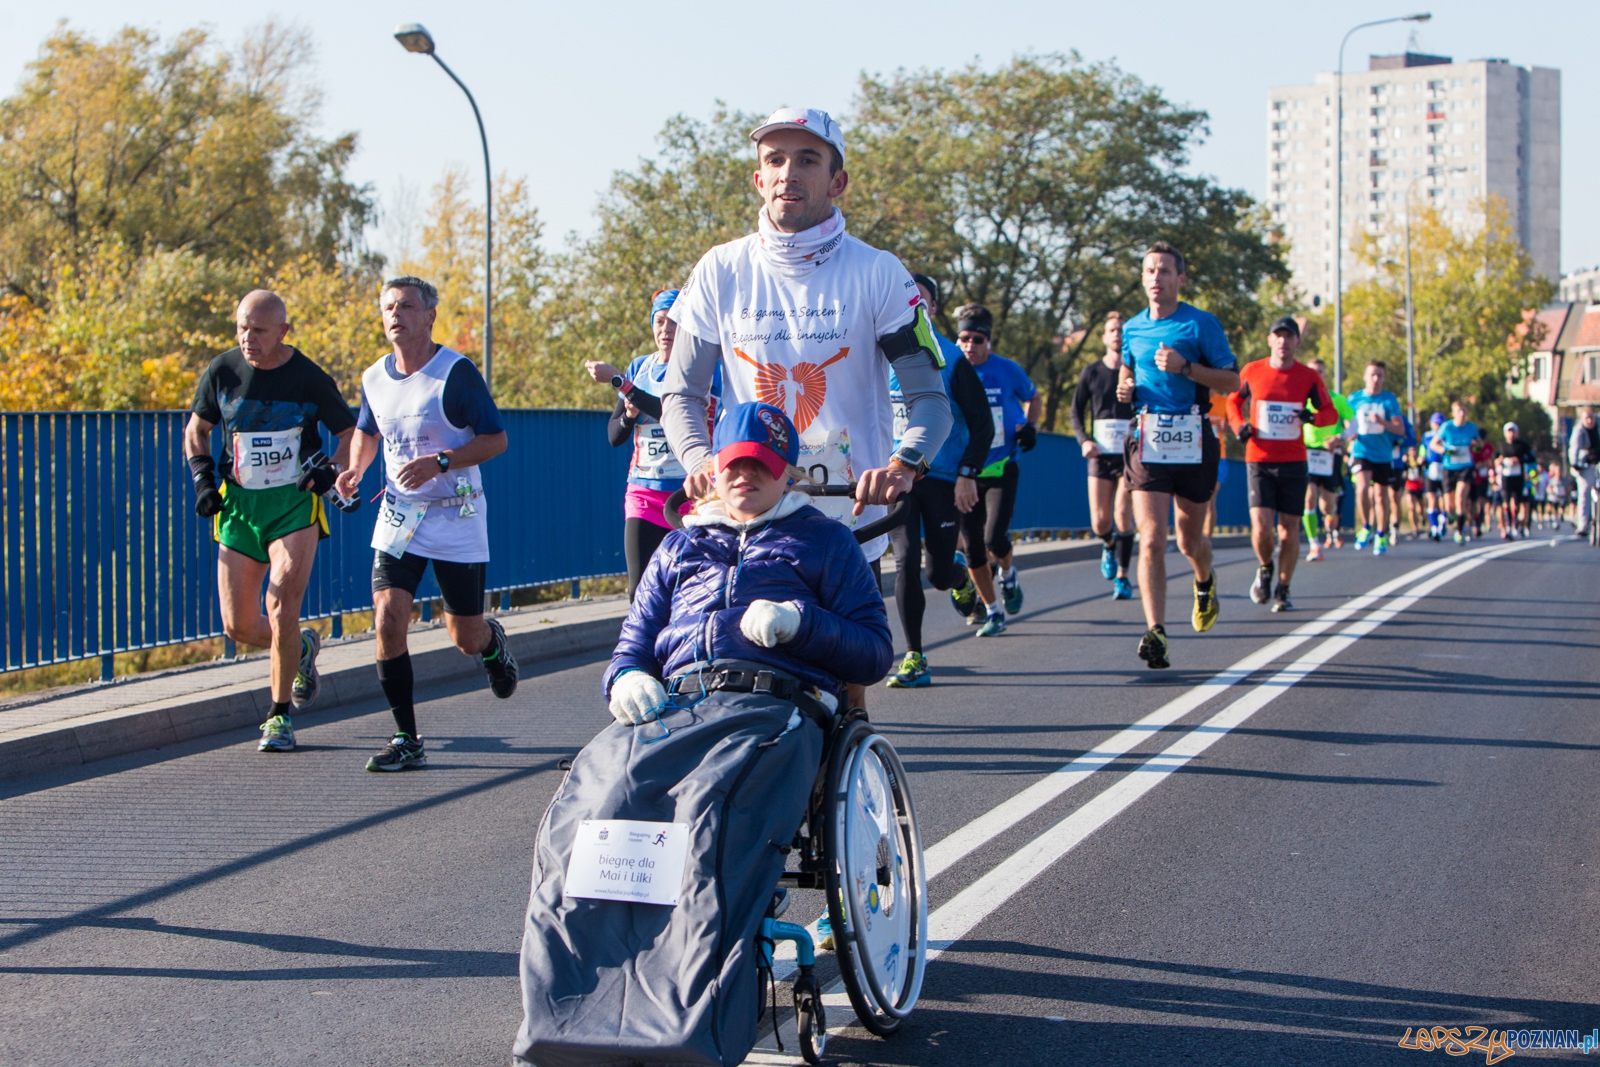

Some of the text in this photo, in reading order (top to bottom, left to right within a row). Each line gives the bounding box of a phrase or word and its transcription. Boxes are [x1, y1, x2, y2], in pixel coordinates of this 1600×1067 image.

[741, 307, 786, 321] Biegamy
[774, 329, 794, 340] dla
[796, 328, 841, 343] innych
[1268, 413, 1294, 424] 1020
[1152, 430, 1193, 443] 2043
[251, 446, 293, 467] 3194
[598, 854, 655, 870] biegnę dla
[599, 869, 652, 884] Mai i Lilki
